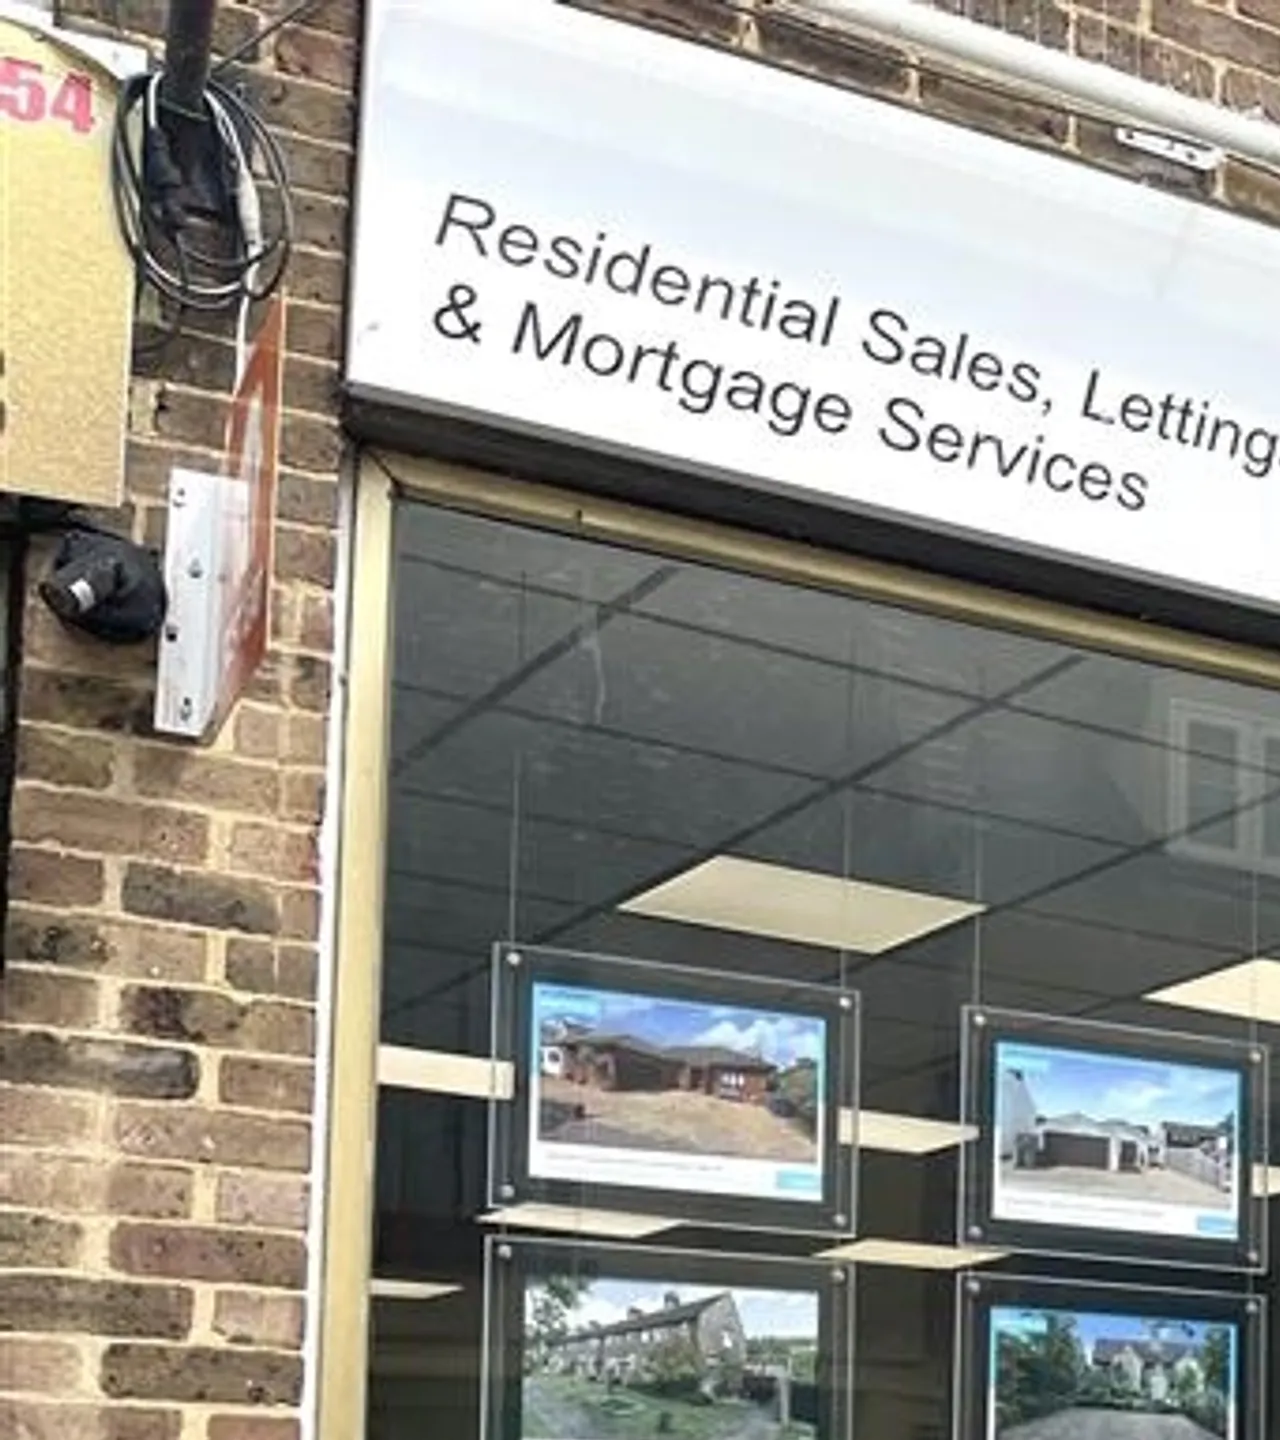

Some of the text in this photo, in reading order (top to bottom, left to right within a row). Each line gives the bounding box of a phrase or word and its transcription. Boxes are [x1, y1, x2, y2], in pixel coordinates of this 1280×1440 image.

[432, 282, 1151, 513] & Mortgage Services
[435, 193, 840, 348] Residential
[862, 309, 1054, 415] Sales,
